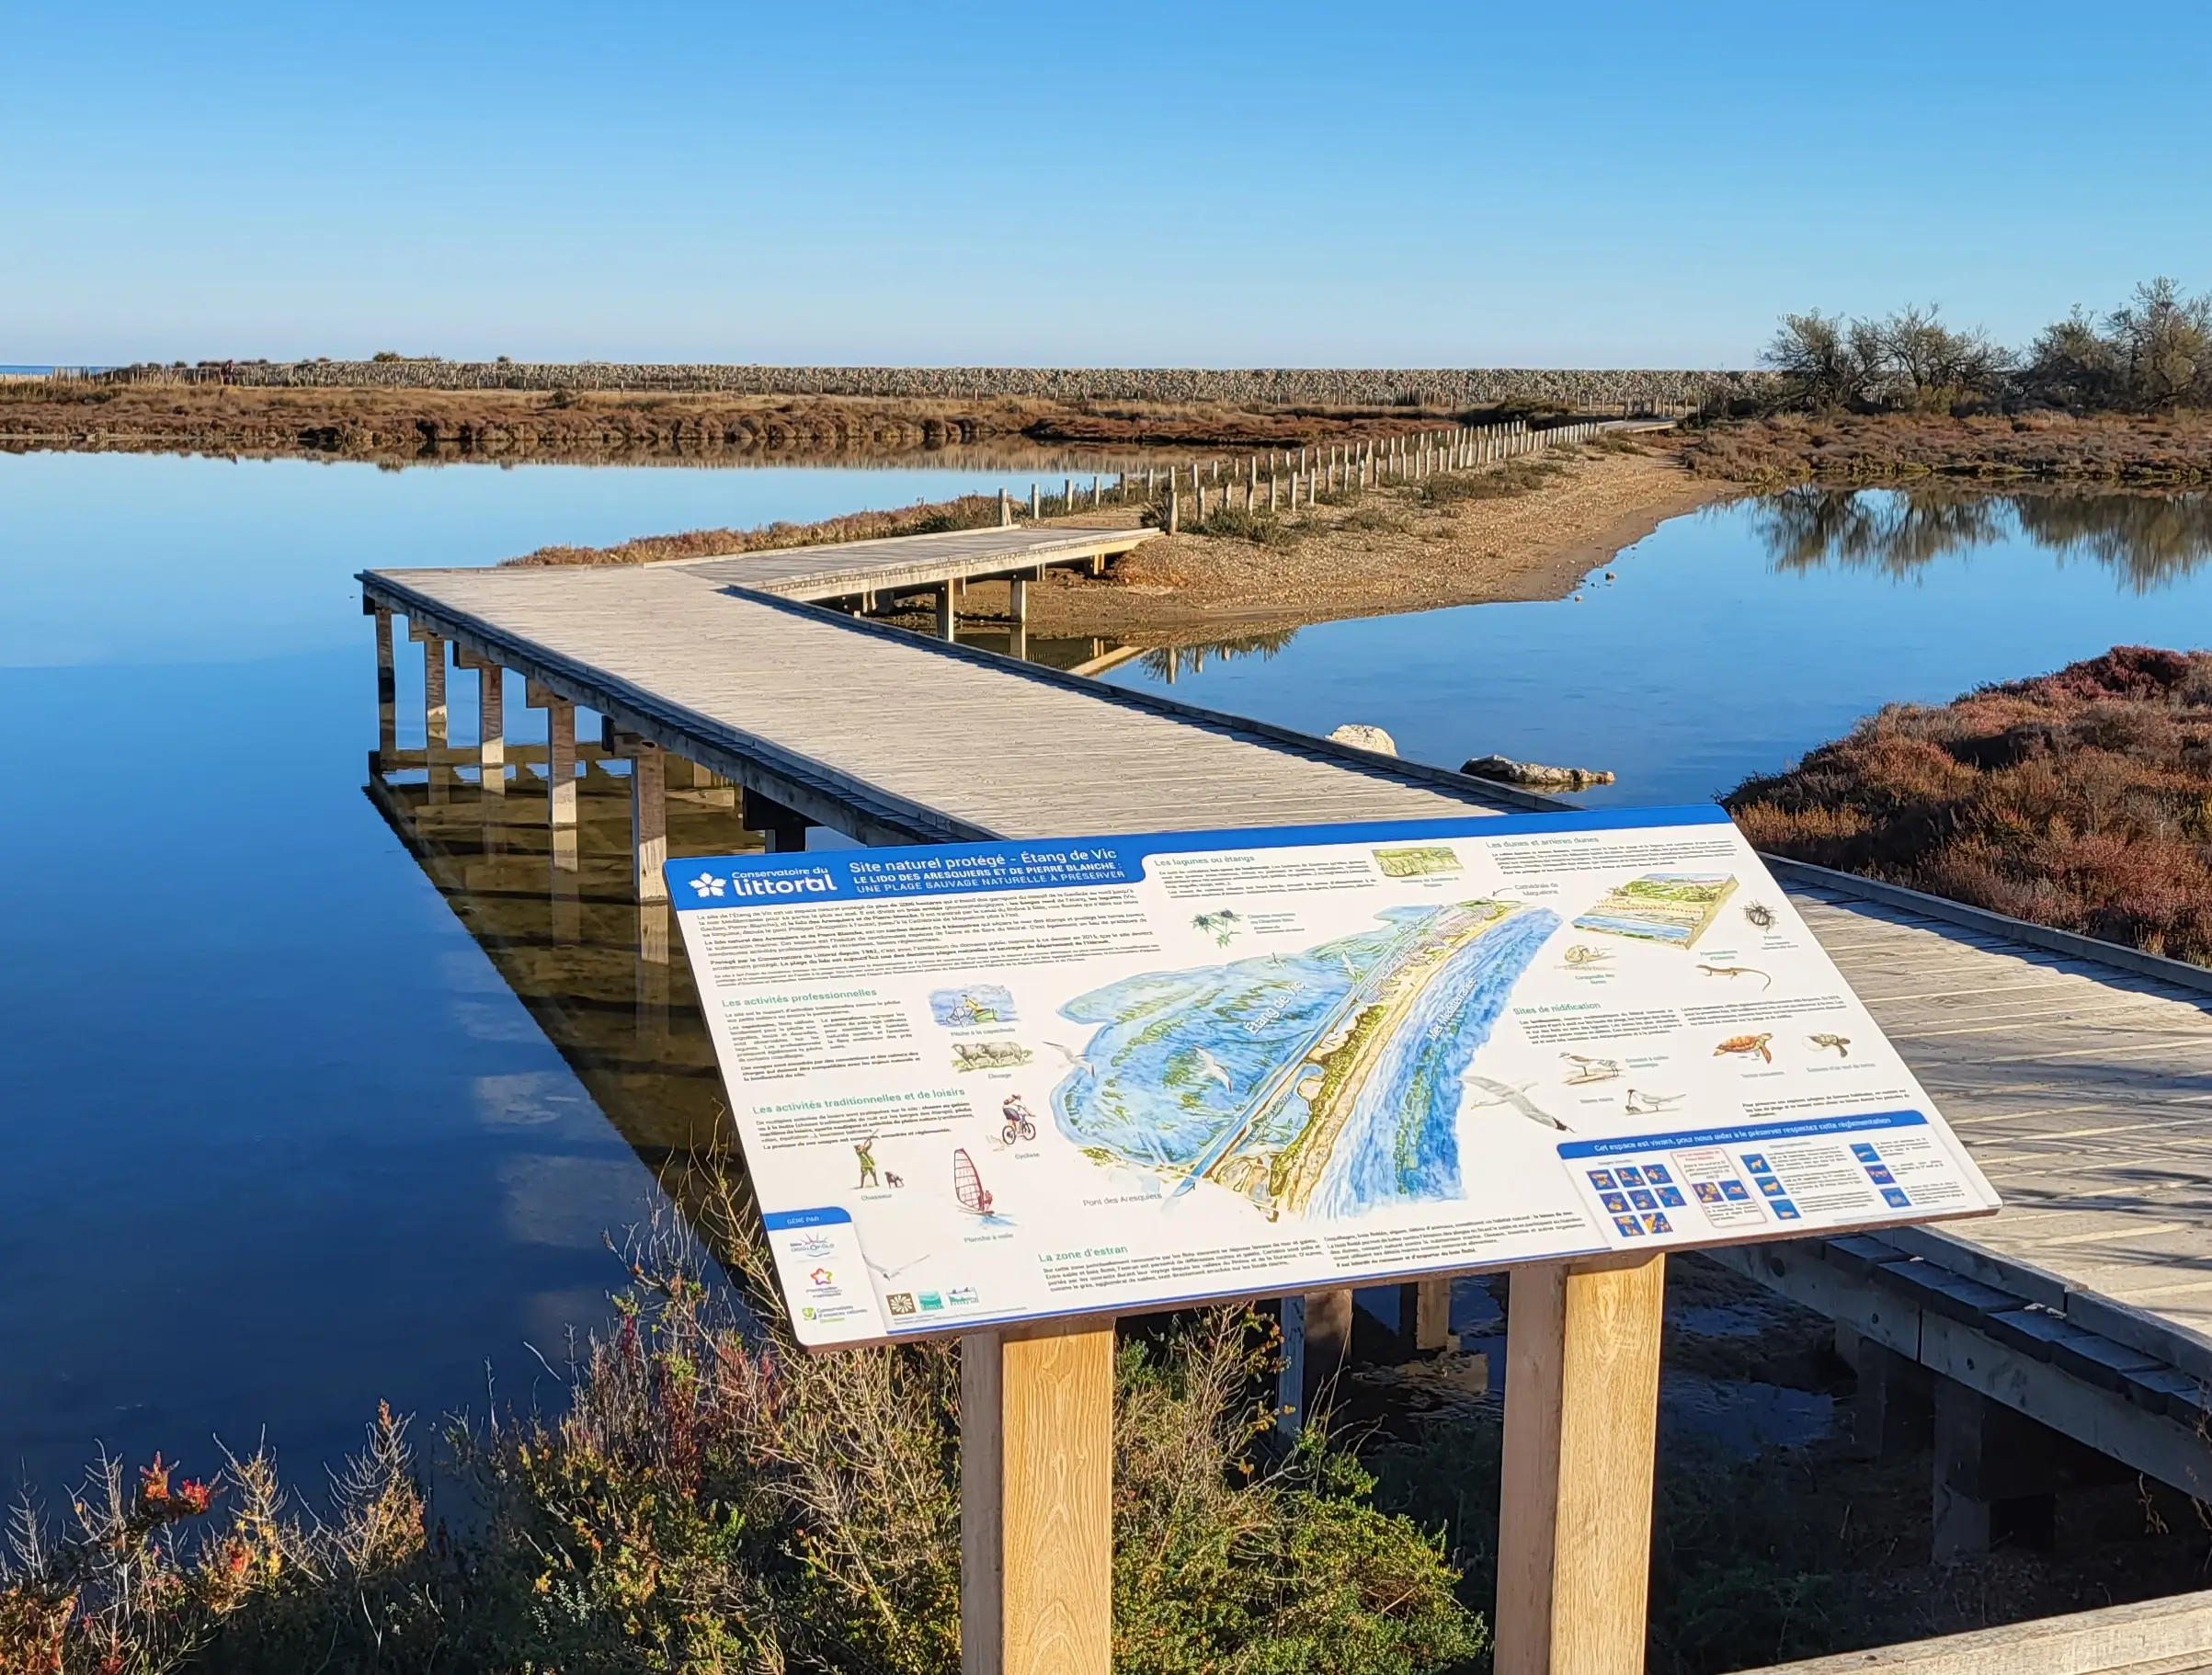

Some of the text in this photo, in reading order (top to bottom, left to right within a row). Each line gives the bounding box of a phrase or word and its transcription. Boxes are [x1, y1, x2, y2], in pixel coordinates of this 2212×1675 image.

[849, 861, 881, 872] Site
[885, 858, 941, 871] naturel
[945, 854, 1006, 870] protégé
[1020, 851, 1066, 863] Étang
[1070, 849, 1089, 860] de
[1091, 849, 1116, 859] Vic
[732, 868, 810, 878] Conservatoire
[924, 870, 991, 880] ARESQUIERS
[1026, 865, 1064, 873] PIERRE
[1066, 862, 1115, 872] BLANCHE
[734, 874, 838, 895] littoral
[884, 883, 922, 891] PLAGE
[926, 879, 979, 889] SAUVAGE
[982, 875, 1047, 885] NATURELLE
[1050, 873, 1058, 882] À
[1060, 871, 1125, 881] PRÉSERVER
[745, 995, 789, 1005] activités
[792, 989, 877, 1003] professionnelles
[1551, 1002, 1601, 1011] nidification
[1243, 1008, 1280, 1036] Étang
[1273, 996, 1291, 1008] de
[776, 1100, 822, 1111] activités
[825, 1094, 901, 1107] traditionnelles
[932, 1088, 965, 1098] loisirs
[1121, 1191, 1162, 1202] Aresquiers
[1038, 1247, 1128, 1262] La zone d'estran
